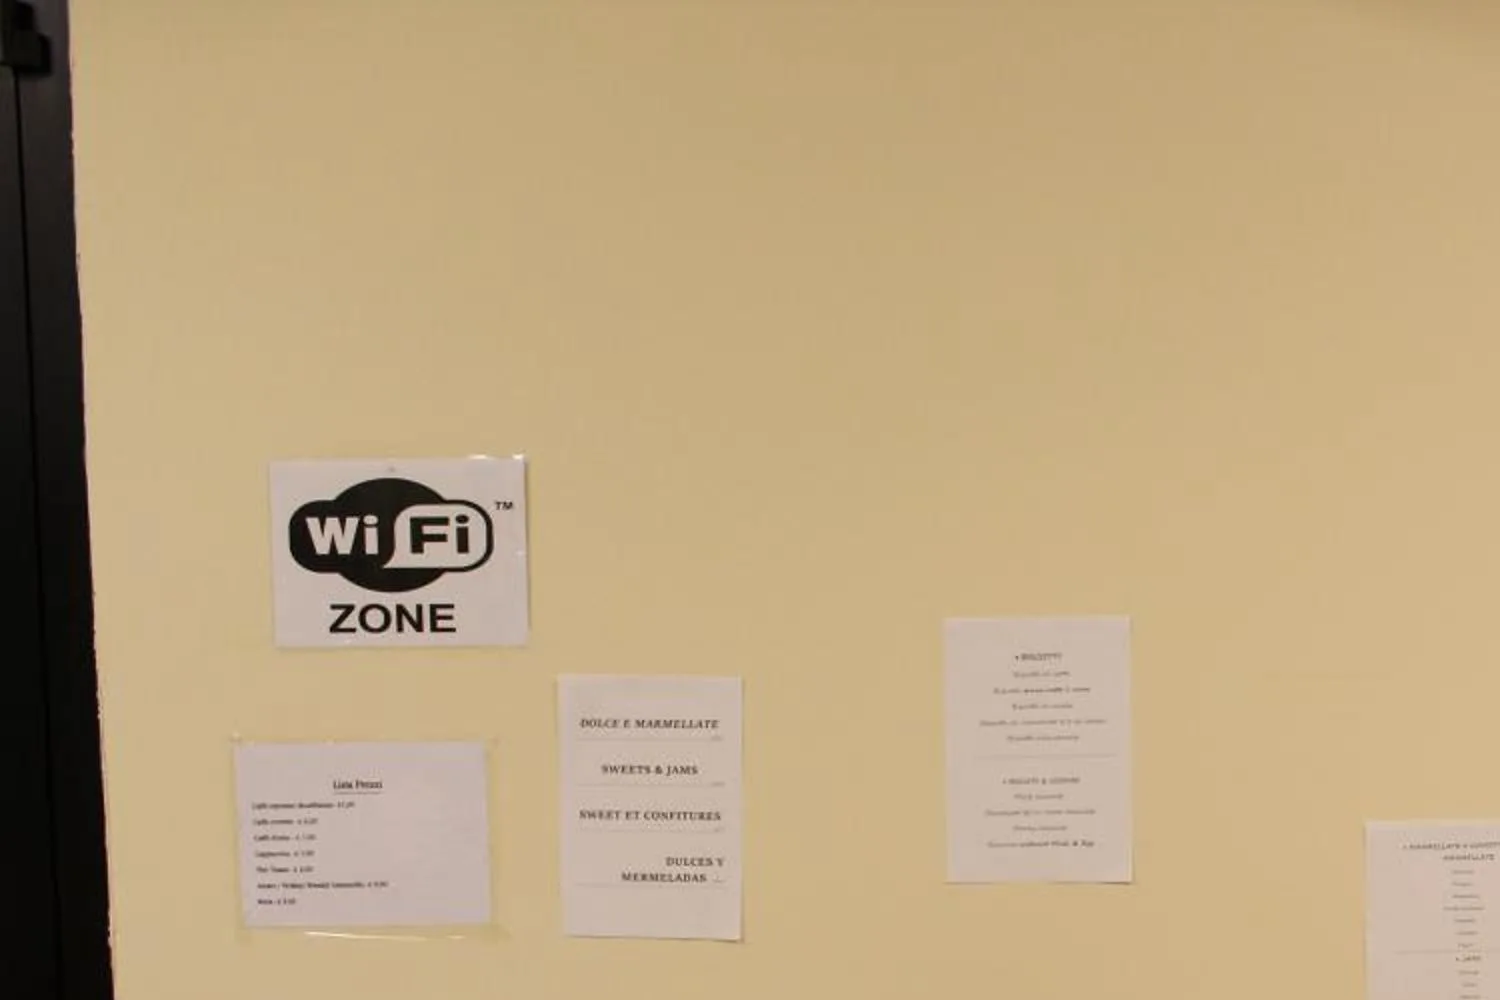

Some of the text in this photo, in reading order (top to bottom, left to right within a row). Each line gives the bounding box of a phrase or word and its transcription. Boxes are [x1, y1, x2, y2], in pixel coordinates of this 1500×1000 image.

[329, 603, 457, 633] ZONE
[579, 719, 720, 729] DOLCE E MARMELLATE
[601, 765, 699, 777] SWEETS & JAMS
[579, 810, 721, 822] SWEET ET CONFITURES
[665, 857, 725, 867] DULCES Y
[621, 872, 707, 883] MERMELADAS
